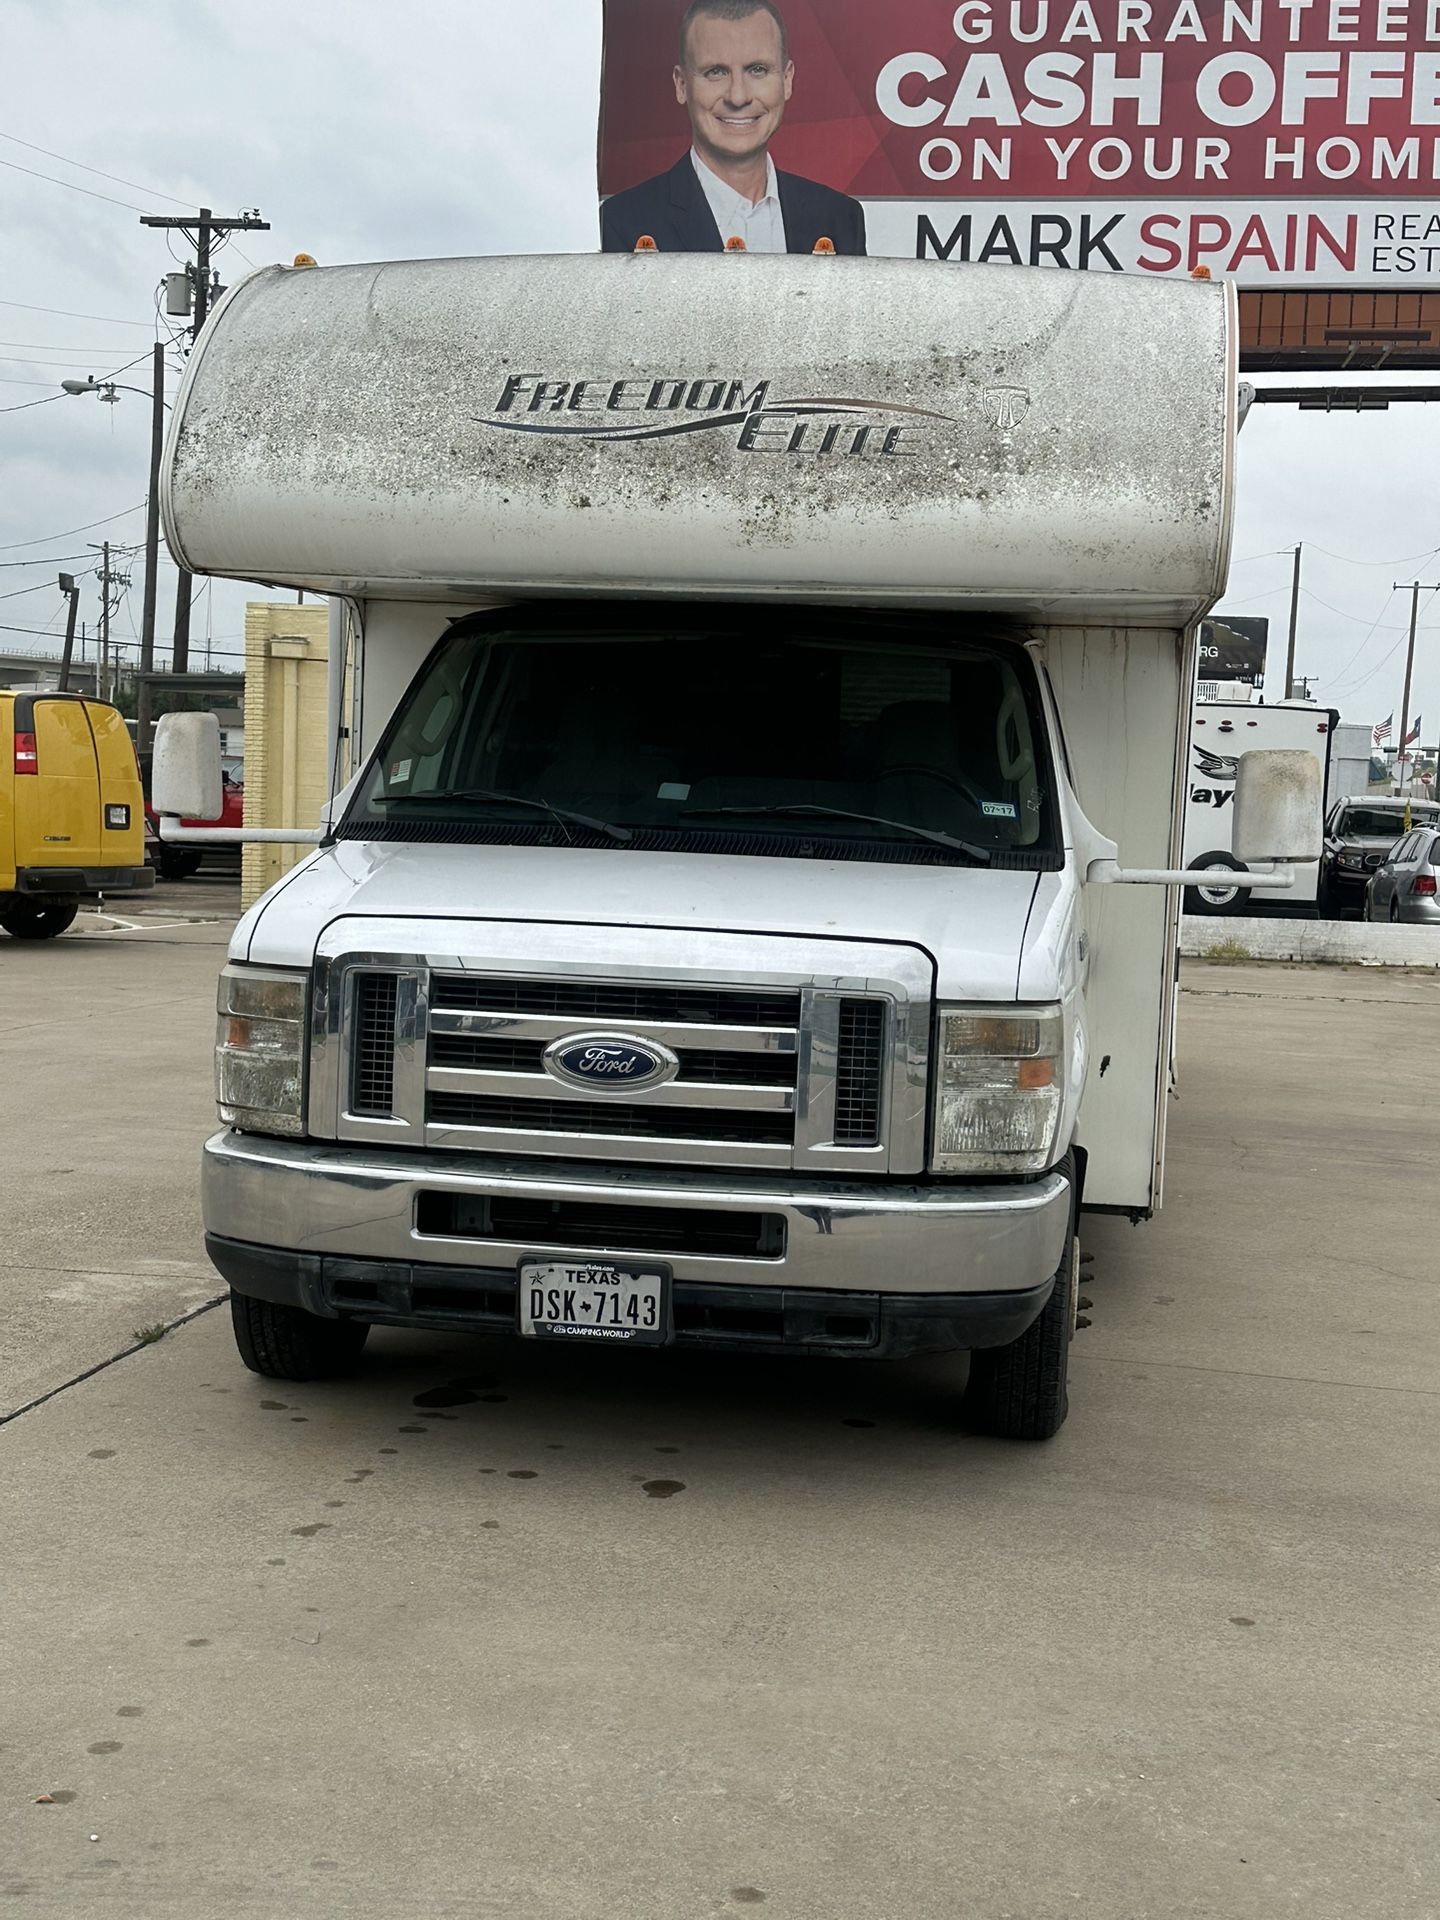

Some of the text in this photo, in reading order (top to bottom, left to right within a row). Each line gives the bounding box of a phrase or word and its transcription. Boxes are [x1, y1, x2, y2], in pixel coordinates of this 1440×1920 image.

[875, 51, 1164, 127] CASH
[919, 136, 1440, 181] ON YOUR HOM
[916, 213, 1358, 273] MARK SPAIN
[1372, 246, 1440, 273] EST
[494, 373, 926, 456] FREEDOM ELITE
[578, 1047, 637, 1074] Ford
[565, 1269, 621, 1286] TEXAS
